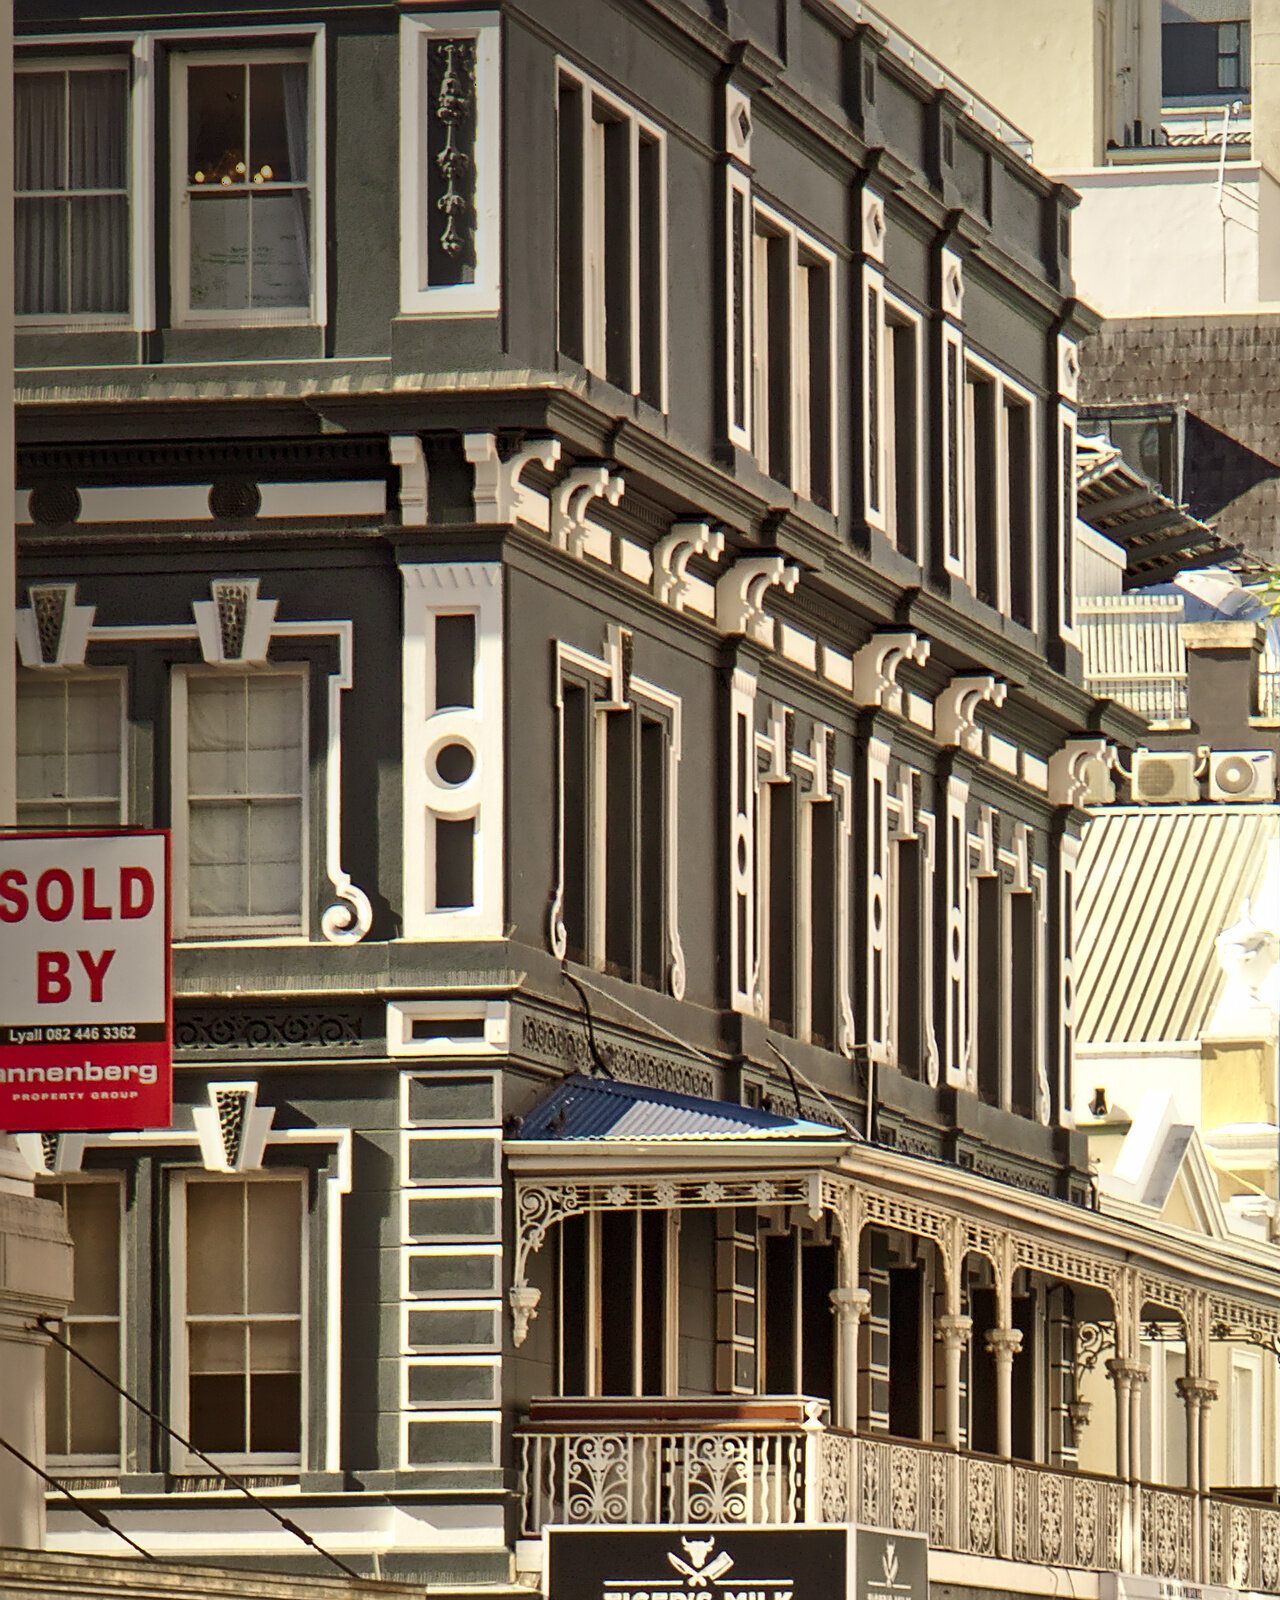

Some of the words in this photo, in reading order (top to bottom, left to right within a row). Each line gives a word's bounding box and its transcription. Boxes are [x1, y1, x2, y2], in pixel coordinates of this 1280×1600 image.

[0, 866, 154, 923] SOLD
[37, 950, 116, 1004] BY
[9, 1029, 42, 1043] Lyall
[47, 1028, 71, 1041] 082
[75, 1027, 100, 1040] 446
[103, 1026, 136, 1040] 3362
[12, 1092, 85, 1101] PROPERTY
[91, 1091, 139, 1100] GROUP
